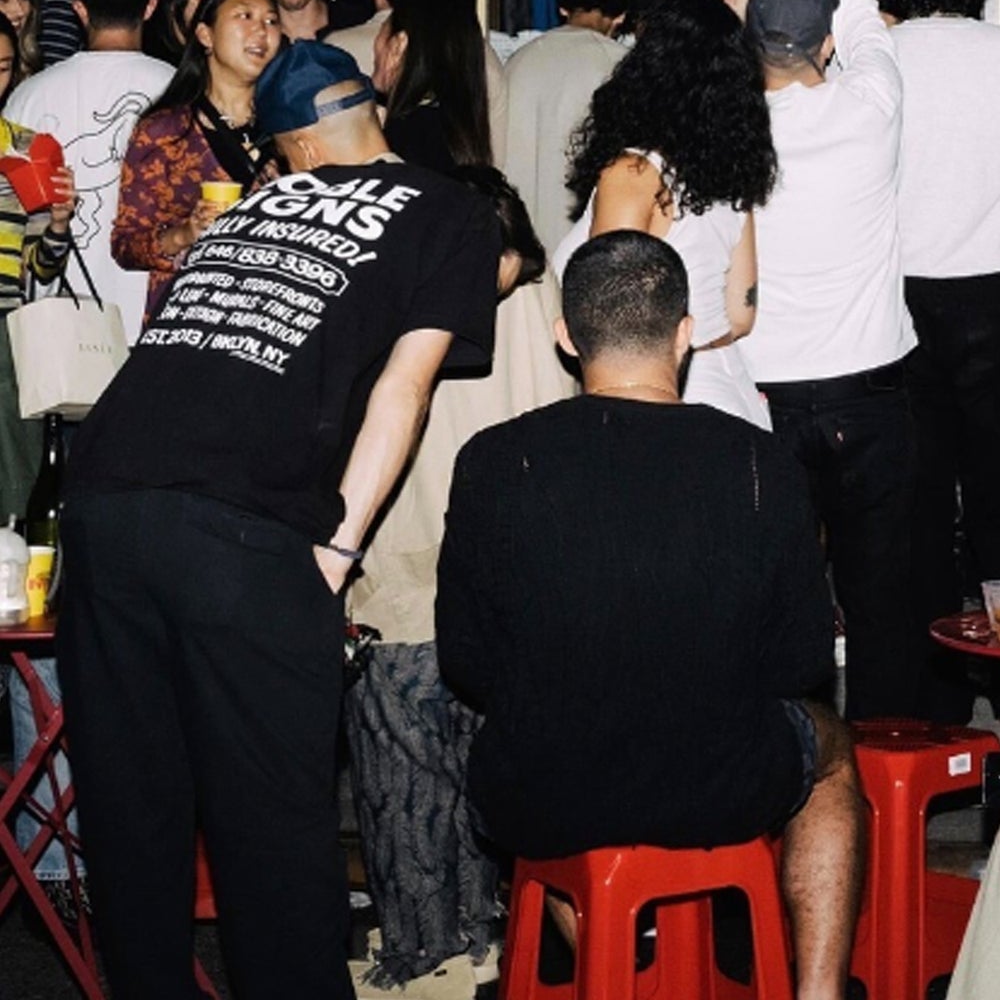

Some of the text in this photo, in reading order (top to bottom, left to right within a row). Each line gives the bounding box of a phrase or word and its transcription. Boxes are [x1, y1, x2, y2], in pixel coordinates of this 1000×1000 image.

[224, 190, 392, 241] IGNS
[249, 219, 378, 267] INSURED!
[262, 344, 292, 367] NY
